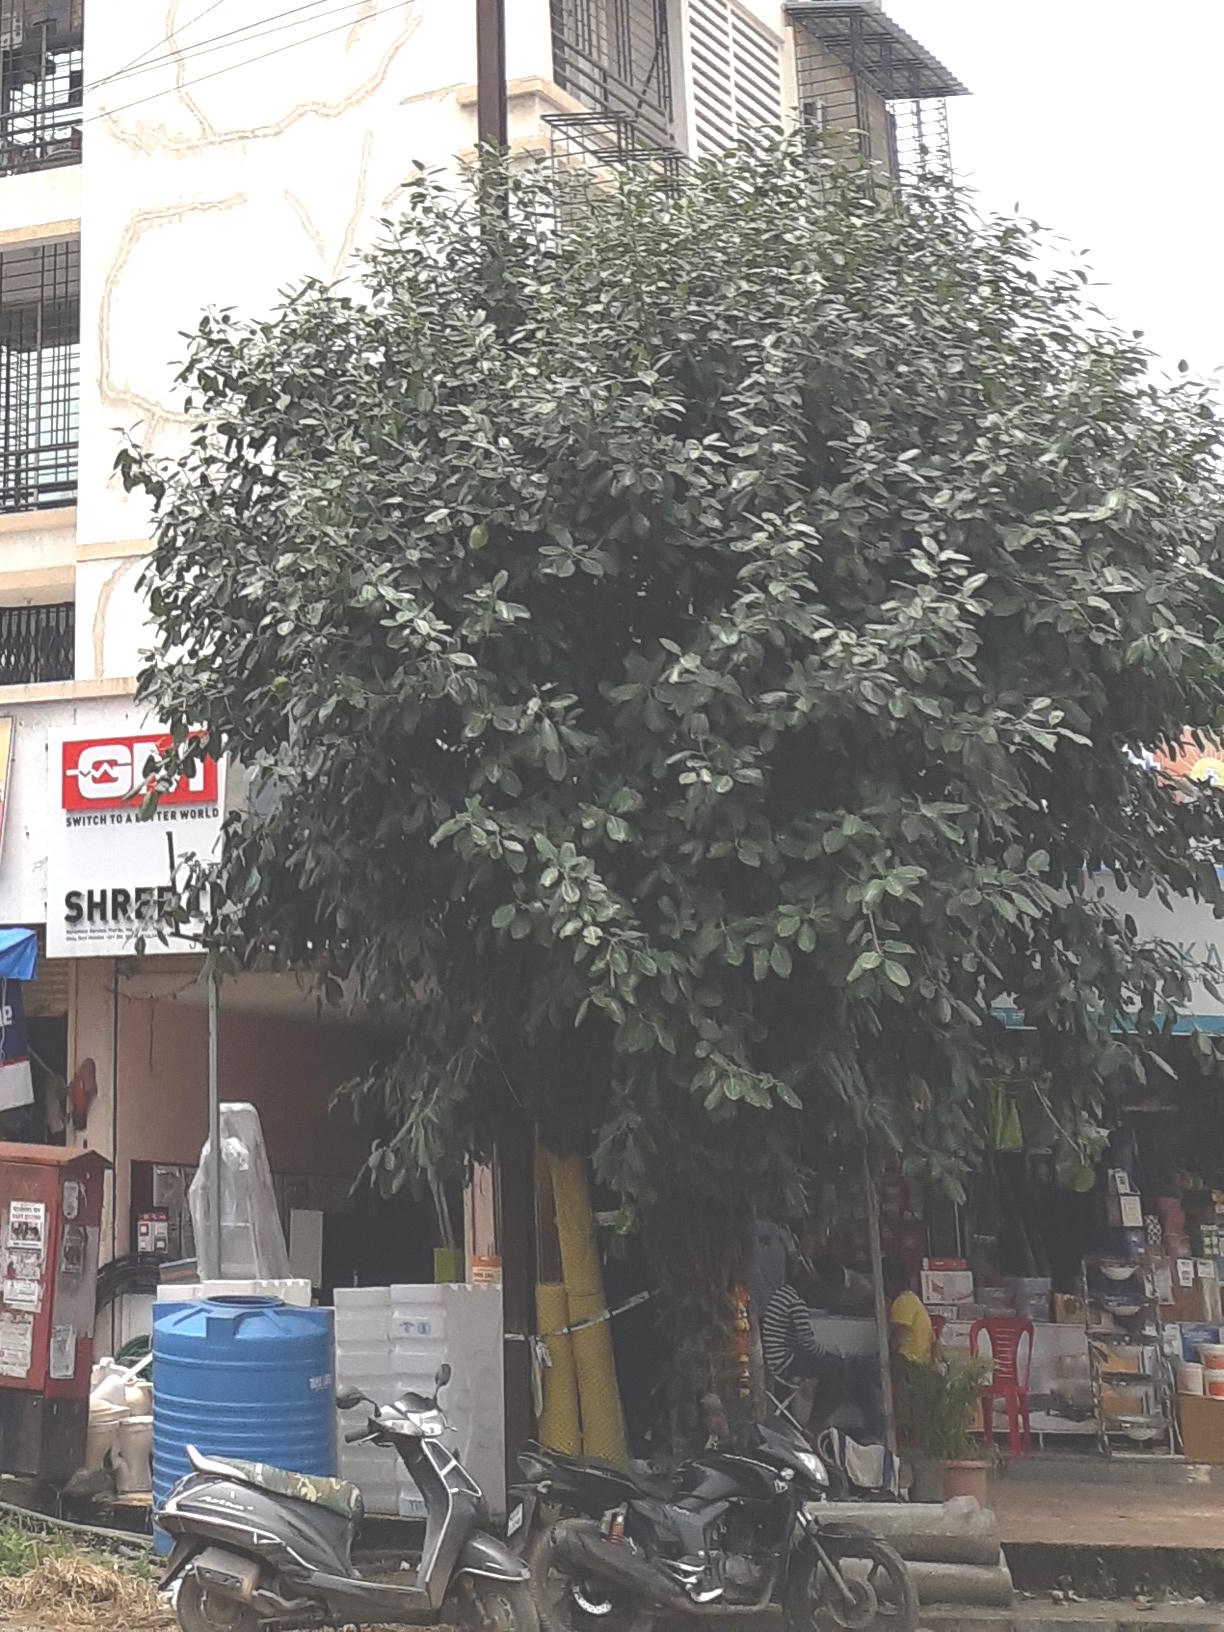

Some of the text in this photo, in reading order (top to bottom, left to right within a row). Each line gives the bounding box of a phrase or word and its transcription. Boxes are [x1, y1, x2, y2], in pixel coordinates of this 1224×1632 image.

[66, 814, 107, 827] SWITCH
[110, 814, 123, 825] TO
[125, 814, 133, 823] A
[179, 808, 220, 821] WORLD
